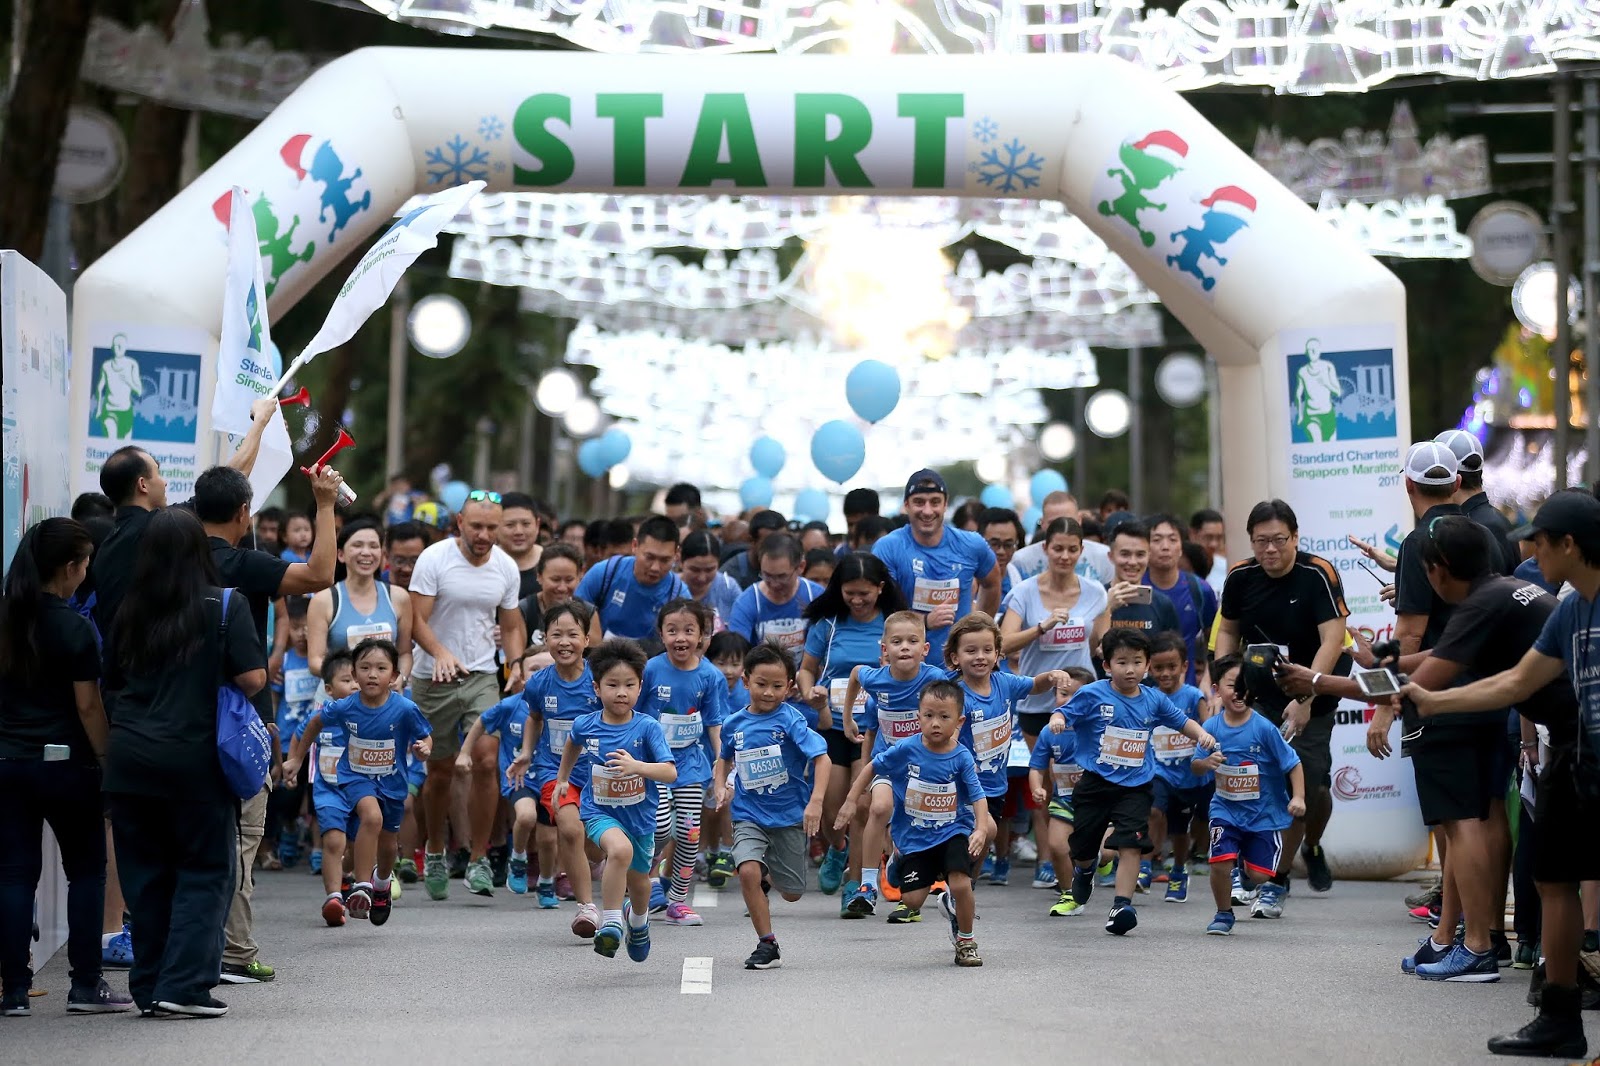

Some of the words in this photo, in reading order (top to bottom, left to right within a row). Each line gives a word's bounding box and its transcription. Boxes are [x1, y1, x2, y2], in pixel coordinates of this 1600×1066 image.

[512, 93, 965, 188] START
[240, 358, 273, 381] Standa
[235, 373, 273, 396] Singapo
[1291, 450, 1344, 466] Standard
[1346, 448, 1399, 461] Chartered
[1292, 467, 1350, 480] Singapore
[1352, 462, 1400, 475] Marathon
[1378, 475, 1400, 487] 2017
[169, 482, 194, 493] 2017
[1056, 628, 1084, 640] D68056
[894, 721, 921, 733] D6805
[362, 750, 393, 762] C67558
[750, 758, 783, 774] B65341
[611, 777, 644, 792] C67178
[1228, 777, 1258, 788] C67252
[925, 795, 956, 807] C65597
[1363, 790, 1401, 800] ATHLETICS
